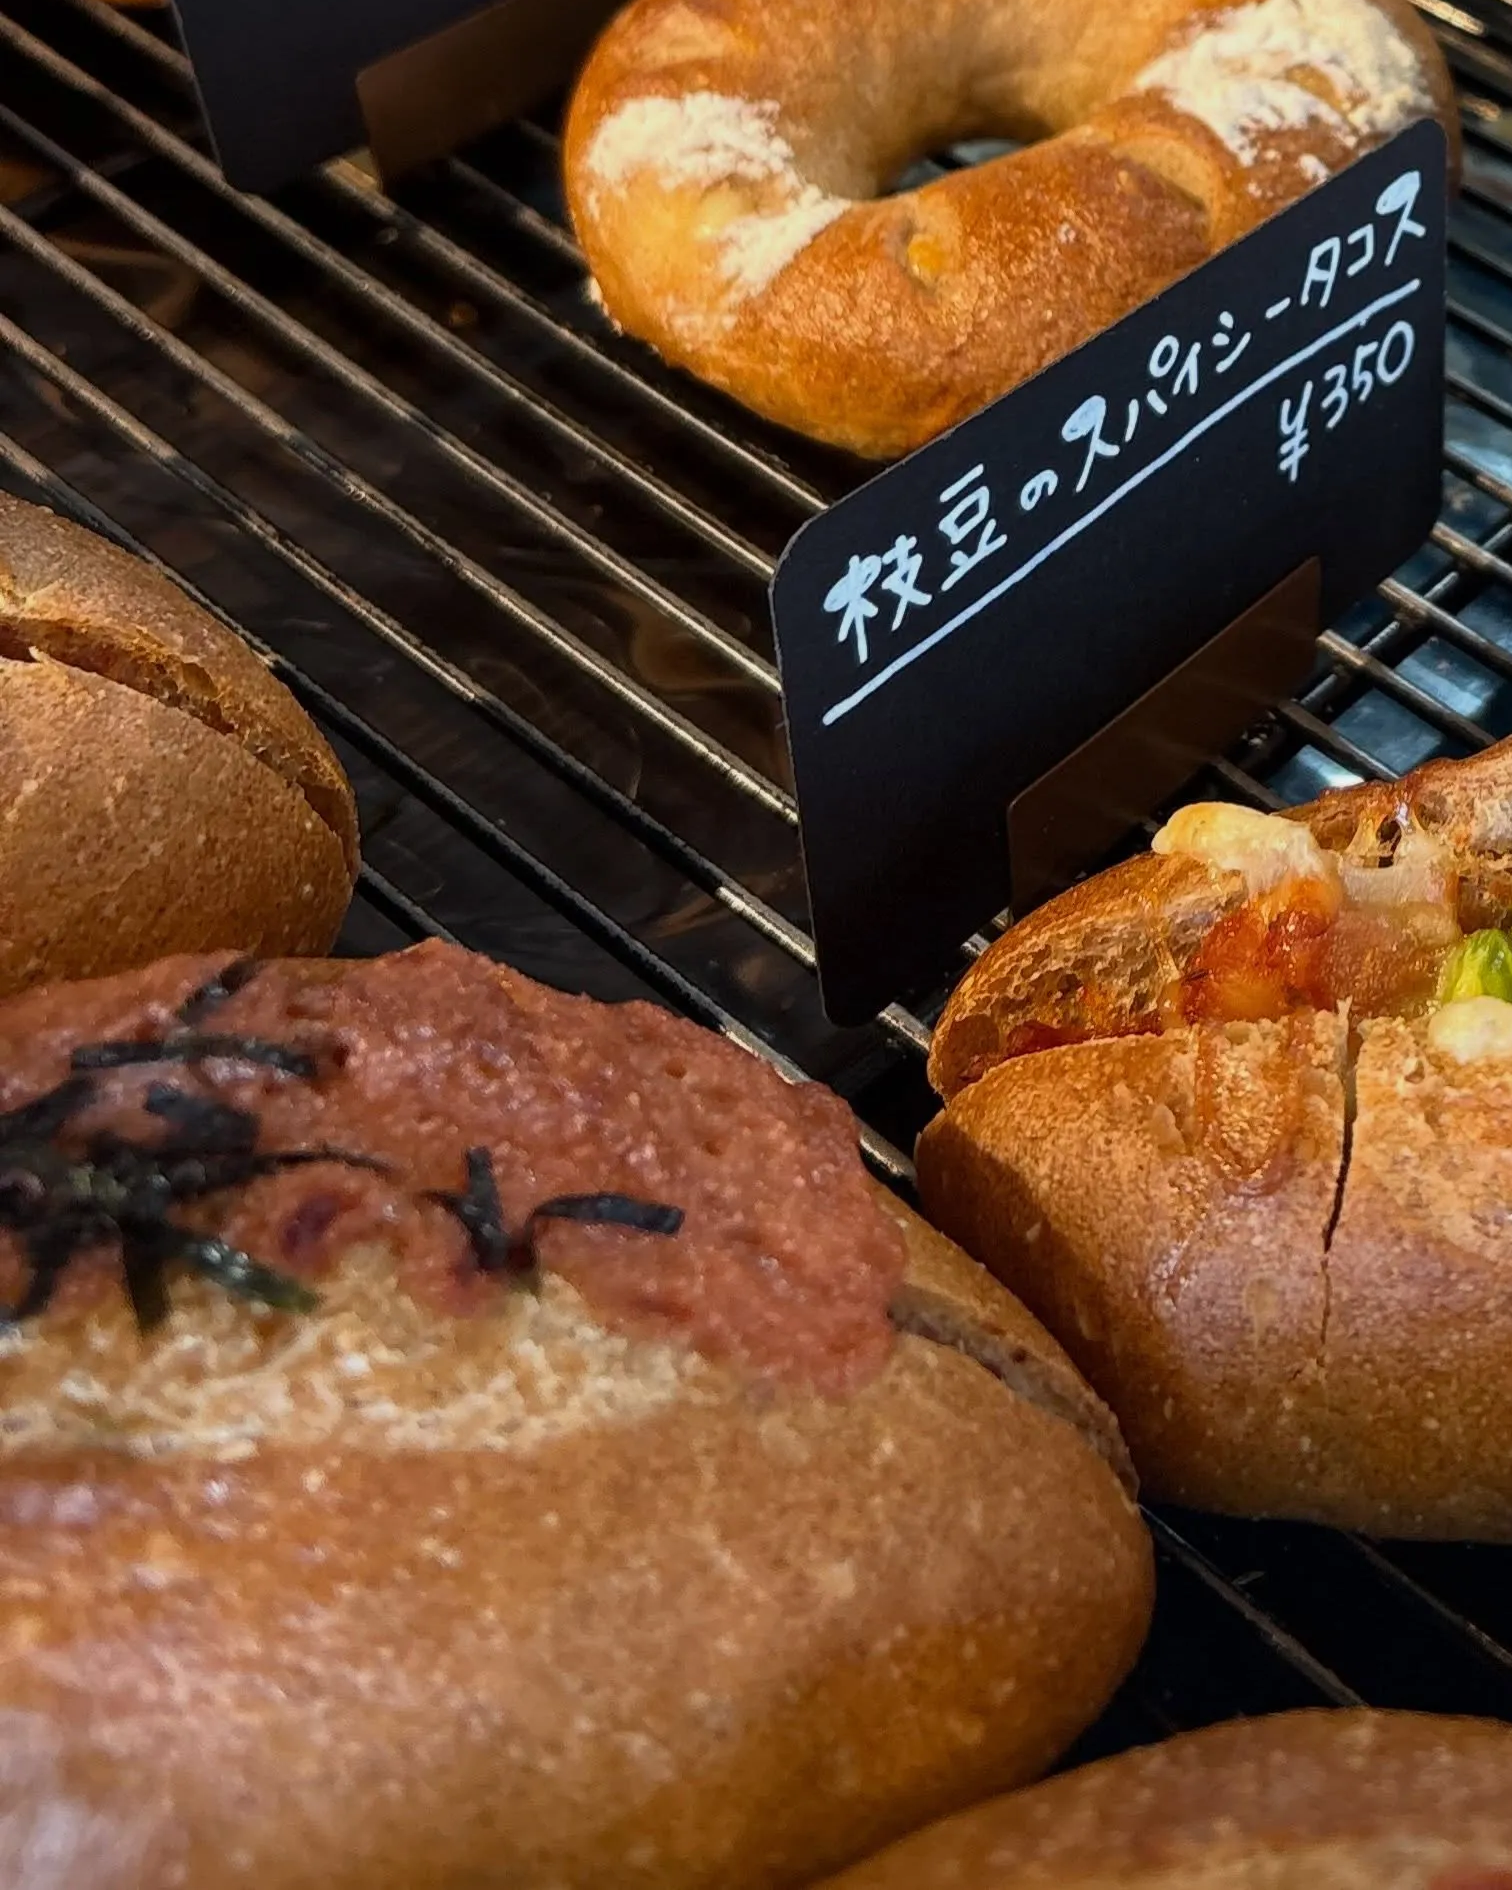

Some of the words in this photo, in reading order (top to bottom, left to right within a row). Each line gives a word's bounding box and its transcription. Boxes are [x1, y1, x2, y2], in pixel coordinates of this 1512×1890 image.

[823, 169, 1426, 664] 枝豆のスパイシータコス
[1279, 320, 1415, 483] ¥350
